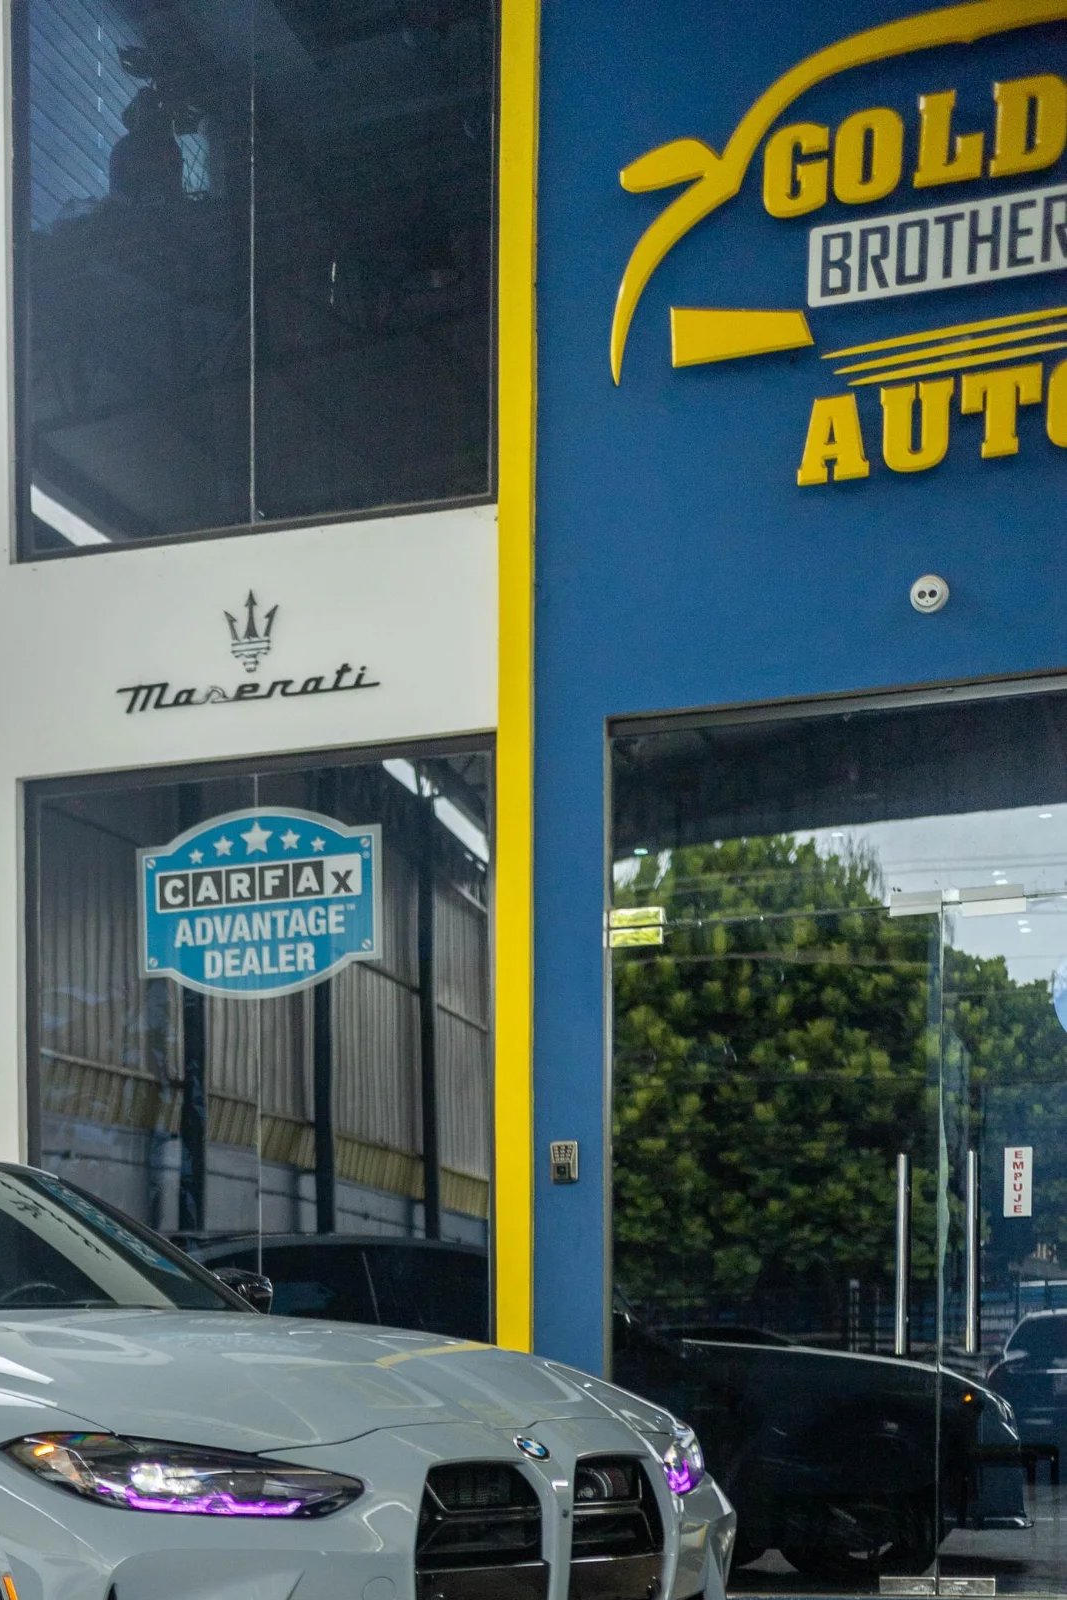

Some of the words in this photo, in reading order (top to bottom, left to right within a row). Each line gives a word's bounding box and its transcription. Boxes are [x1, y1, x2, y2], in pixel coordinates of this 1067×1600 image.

[763, 73, 1067, 218] GOLD
[163, 866, 354, 905] CARFAX
[204, 942, 315, 979] DEALER
[1013, 1150, 1024, 1213] EMPUJE
